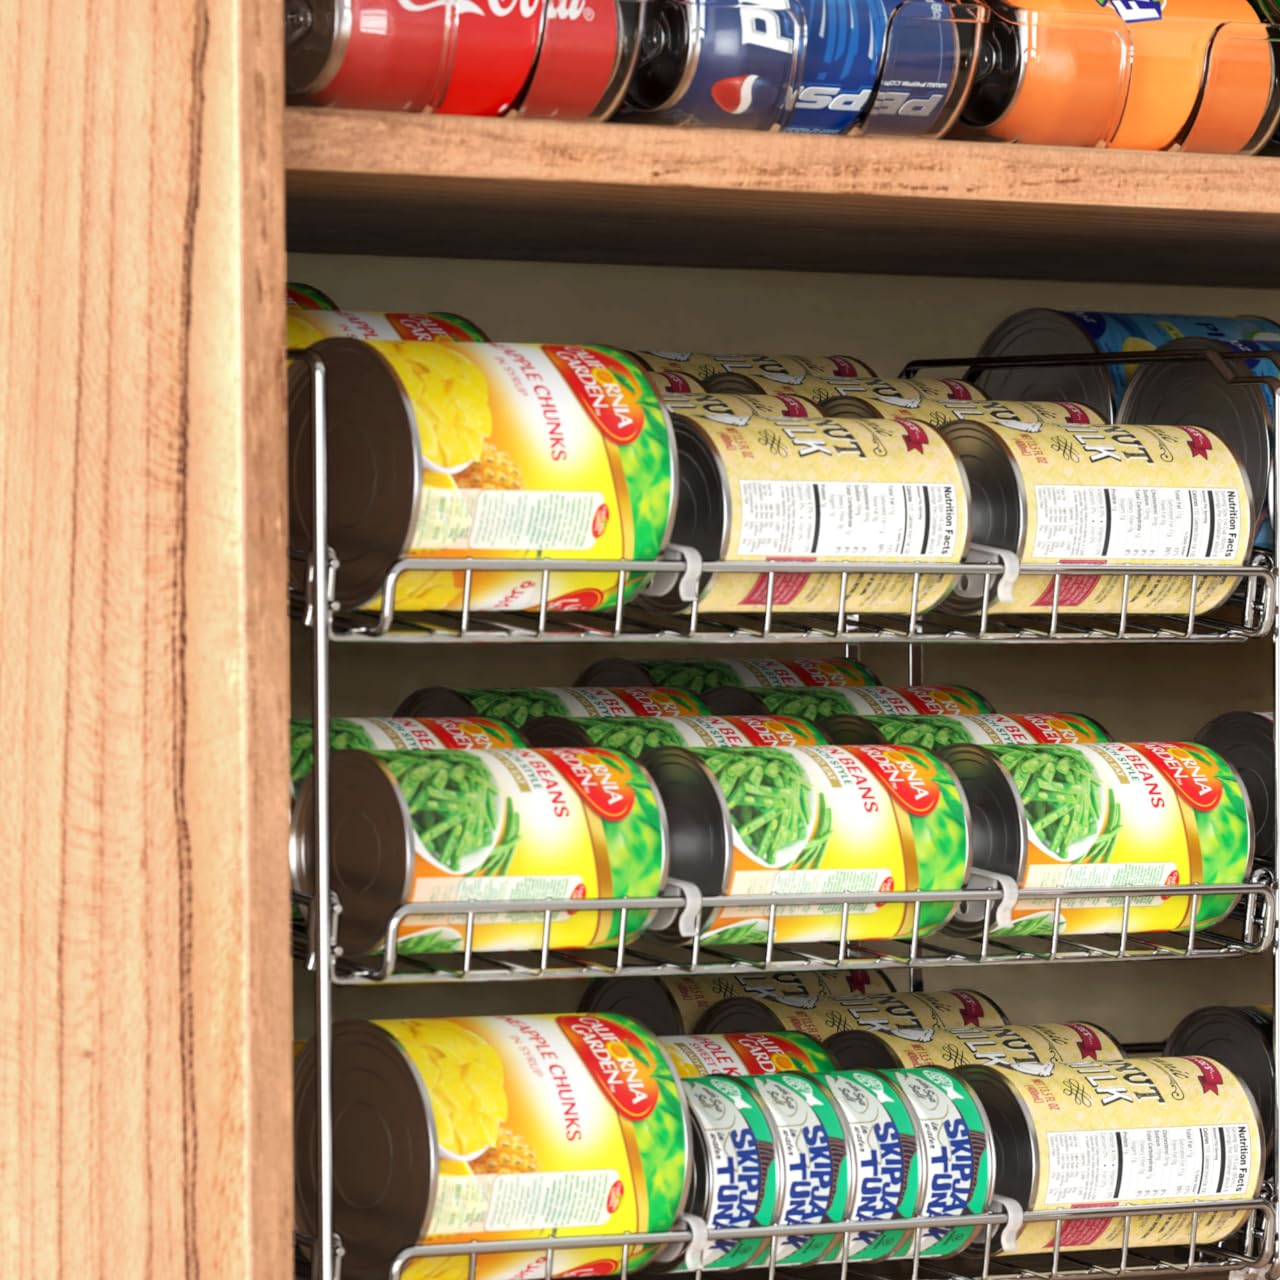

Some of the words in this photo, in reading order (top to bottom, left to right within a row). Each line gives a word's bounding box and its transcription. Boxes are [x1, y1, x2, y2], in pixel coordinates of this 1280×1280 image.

[557, 351, 608, 409] GARDEN
[534, 384, 567, 461] CHUNKS
[944, 487, 953, 527] Nutrition
[1227, 491, 1237, 530] Nutrition
[941, 530, 953, 554] Facts
[1225, 533, 1237, 557] Facts
[530, 760, 570, 818] BEANS
[839, 757, 878, 813] BEANS
[1117, 757, 1140, 781] STYLE
[1126, 755, 1165, 809] BEANS
[570, 1025, 624, 1092] GARDEN
[549, 1061, 582, 1142] CHUNKS
[1237, 1126, 1247, 1166] Nutrition
[731, 1128, 759, 1228] SKIPJA
[1235, 1167, 1244, 1192] Facts
